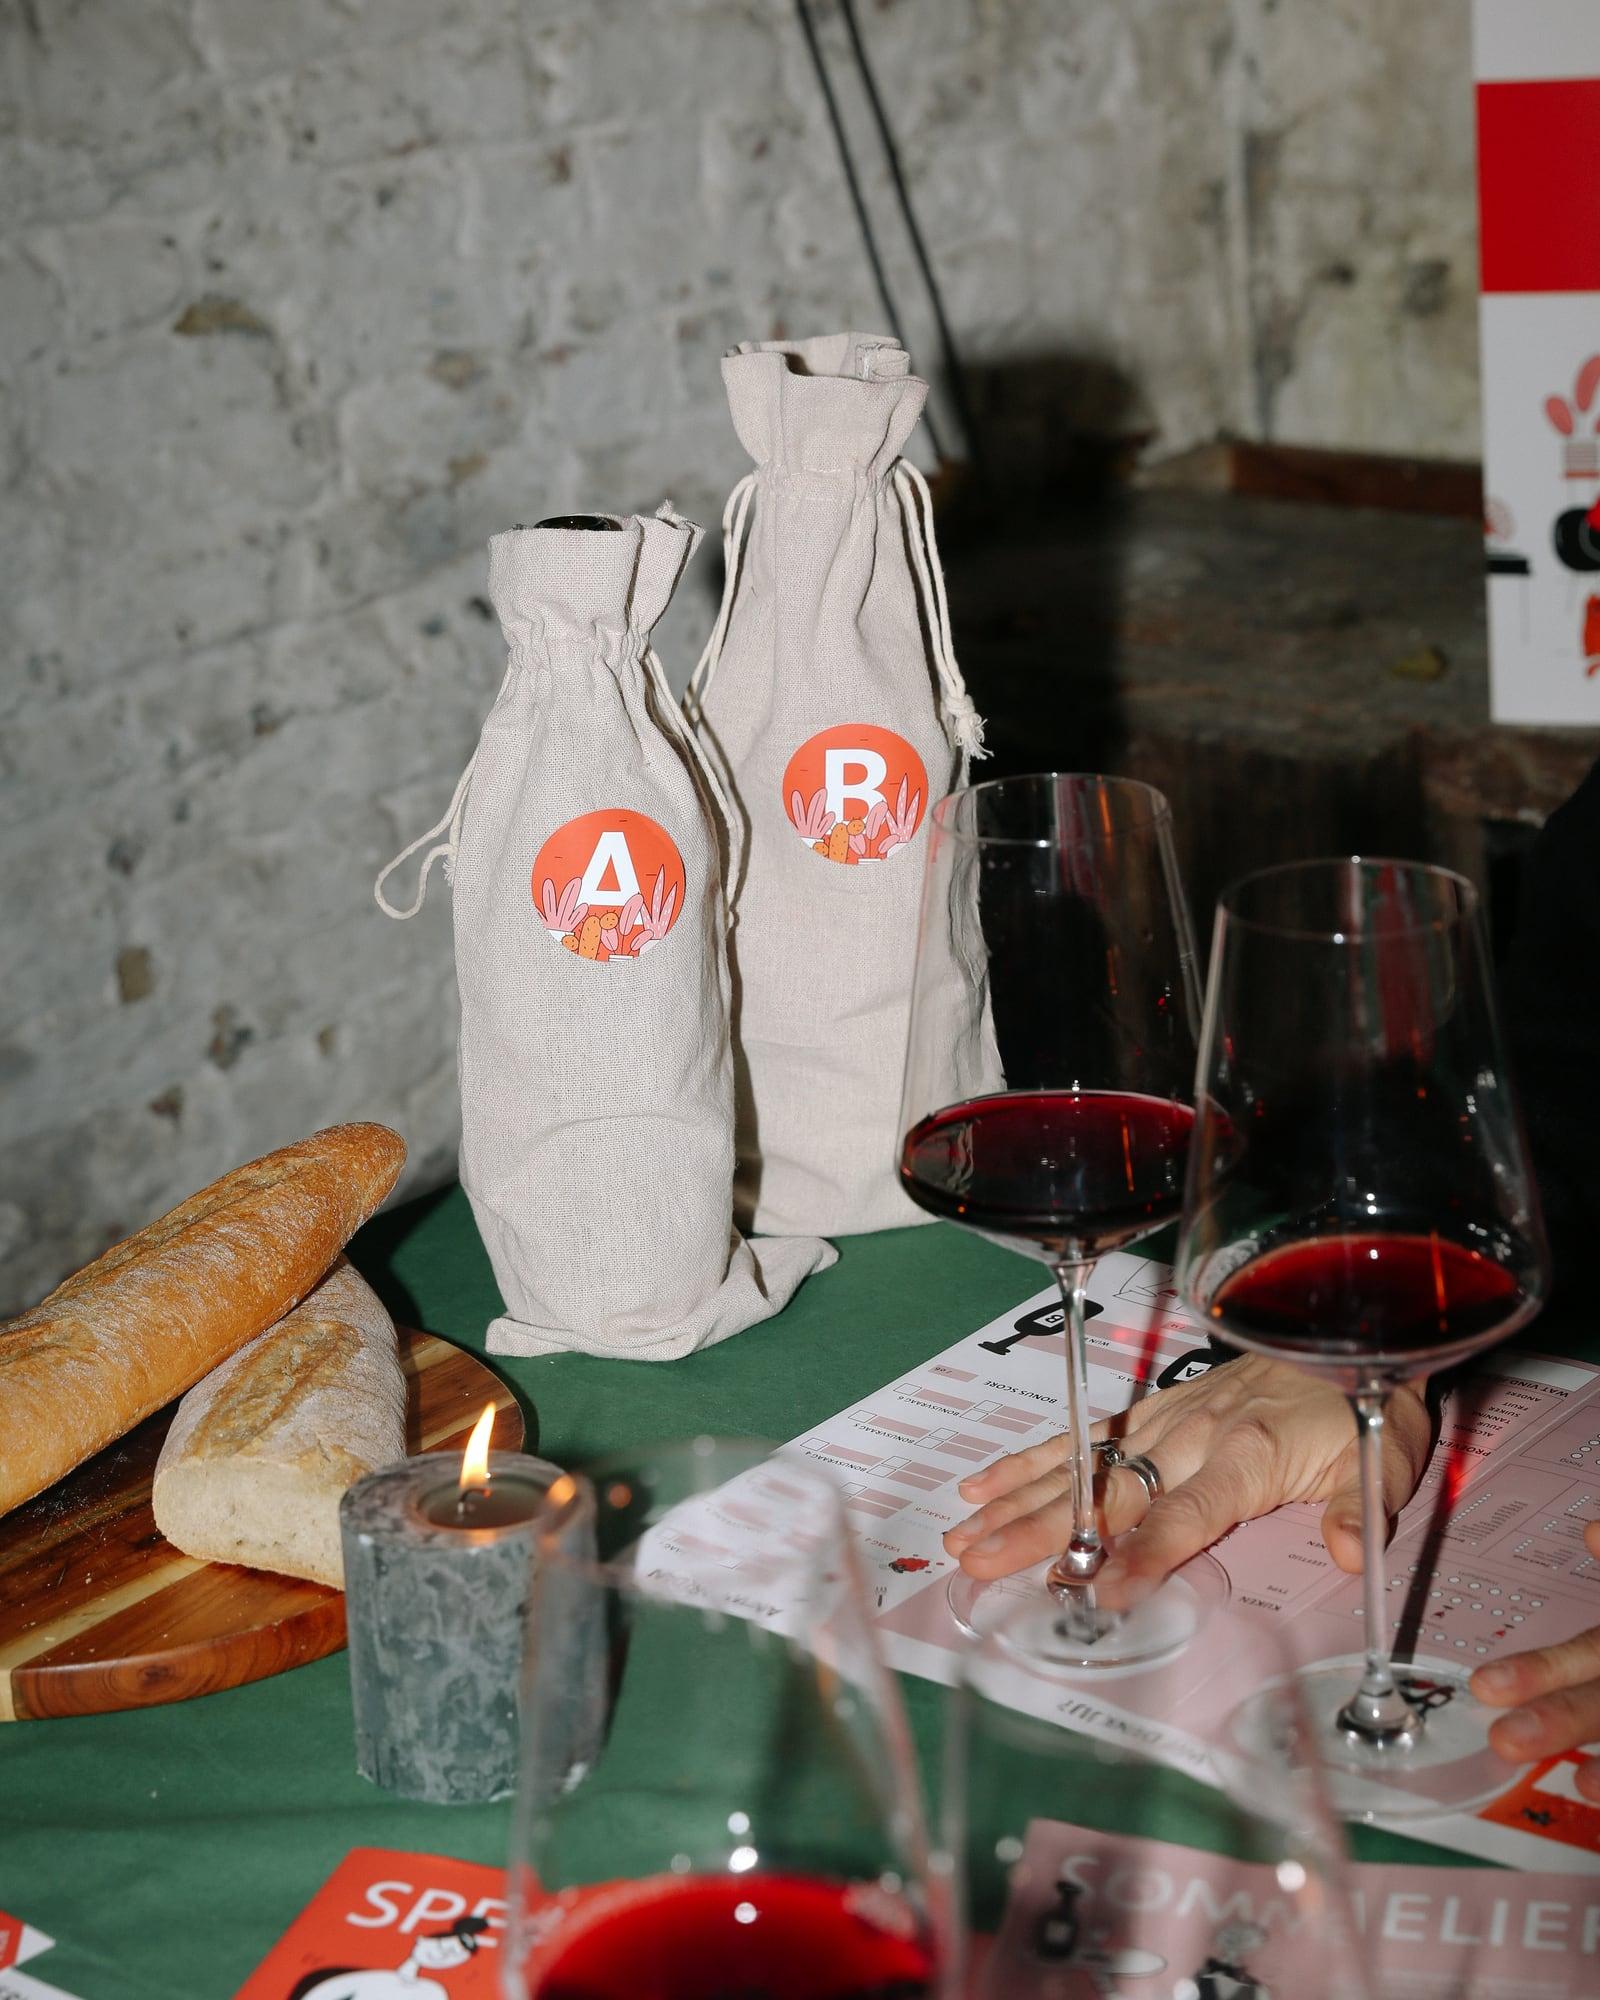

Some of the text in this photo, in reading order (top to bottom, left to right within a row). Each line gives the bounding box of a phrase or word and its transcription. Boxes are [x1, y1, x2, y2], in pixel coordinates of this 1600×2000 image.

[825, 749, 888, 834] B
[577, 831, 644, 926] A
[1185, 1366, 1204, 1378] A
[983, 1380, 1058, 1404] BONUS SCORE
[1509, 1379, 1570, 1398] WAT VIND
[903, 1397, 960, 1417] BONUSVRAAG
[858, 1425, 915, 1444] BONUSVRAAG
[809, 1453, 867, 1472] BONUSVRAAG
[346, 1880, 512, 1948] SPE
